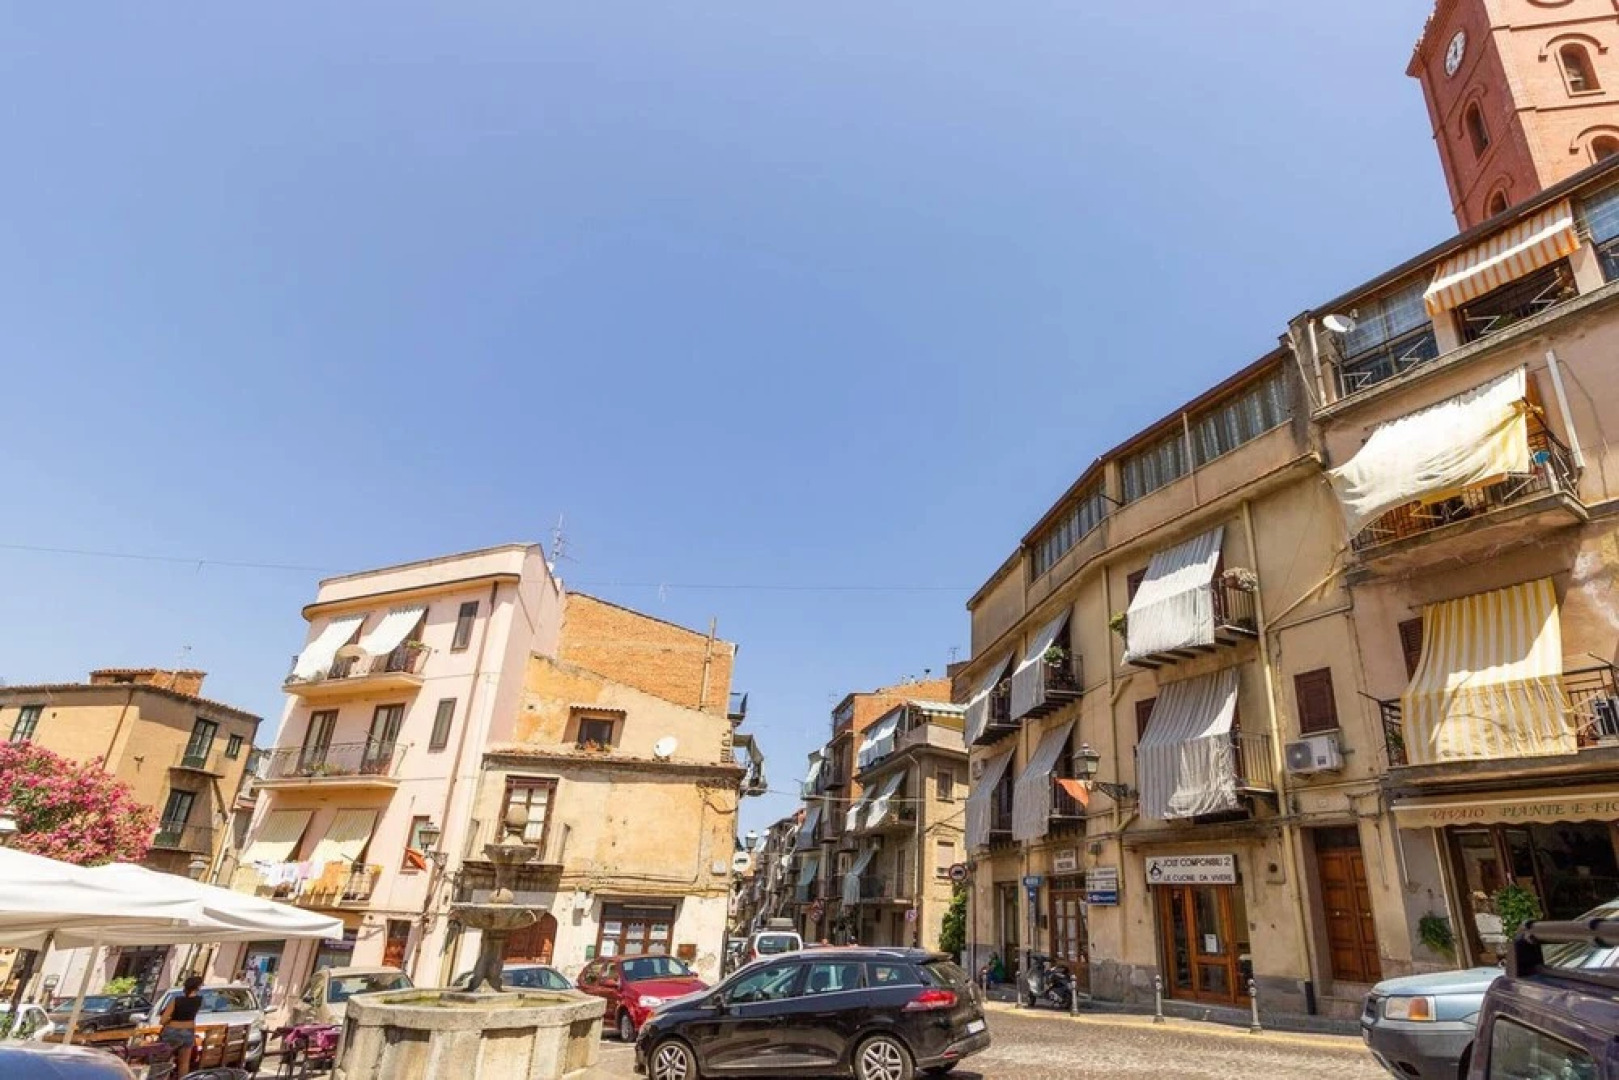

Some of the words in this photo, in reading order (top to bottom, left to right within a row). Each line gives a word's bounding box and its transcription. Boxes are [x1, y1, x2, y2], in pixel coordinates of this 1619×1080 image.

[1430, 808, 1485, 821] VIVAIO
[1502, 804, 1565, 817] PIANTE
[1572, 802, 1586, 814] E
[1224, 856, 1231, 866] 2
[1172, 873, 1195, 882] CUCINE
[1199, 873, 1208, 881] DA
[1211, 873, 1233, 881] VIVERE
